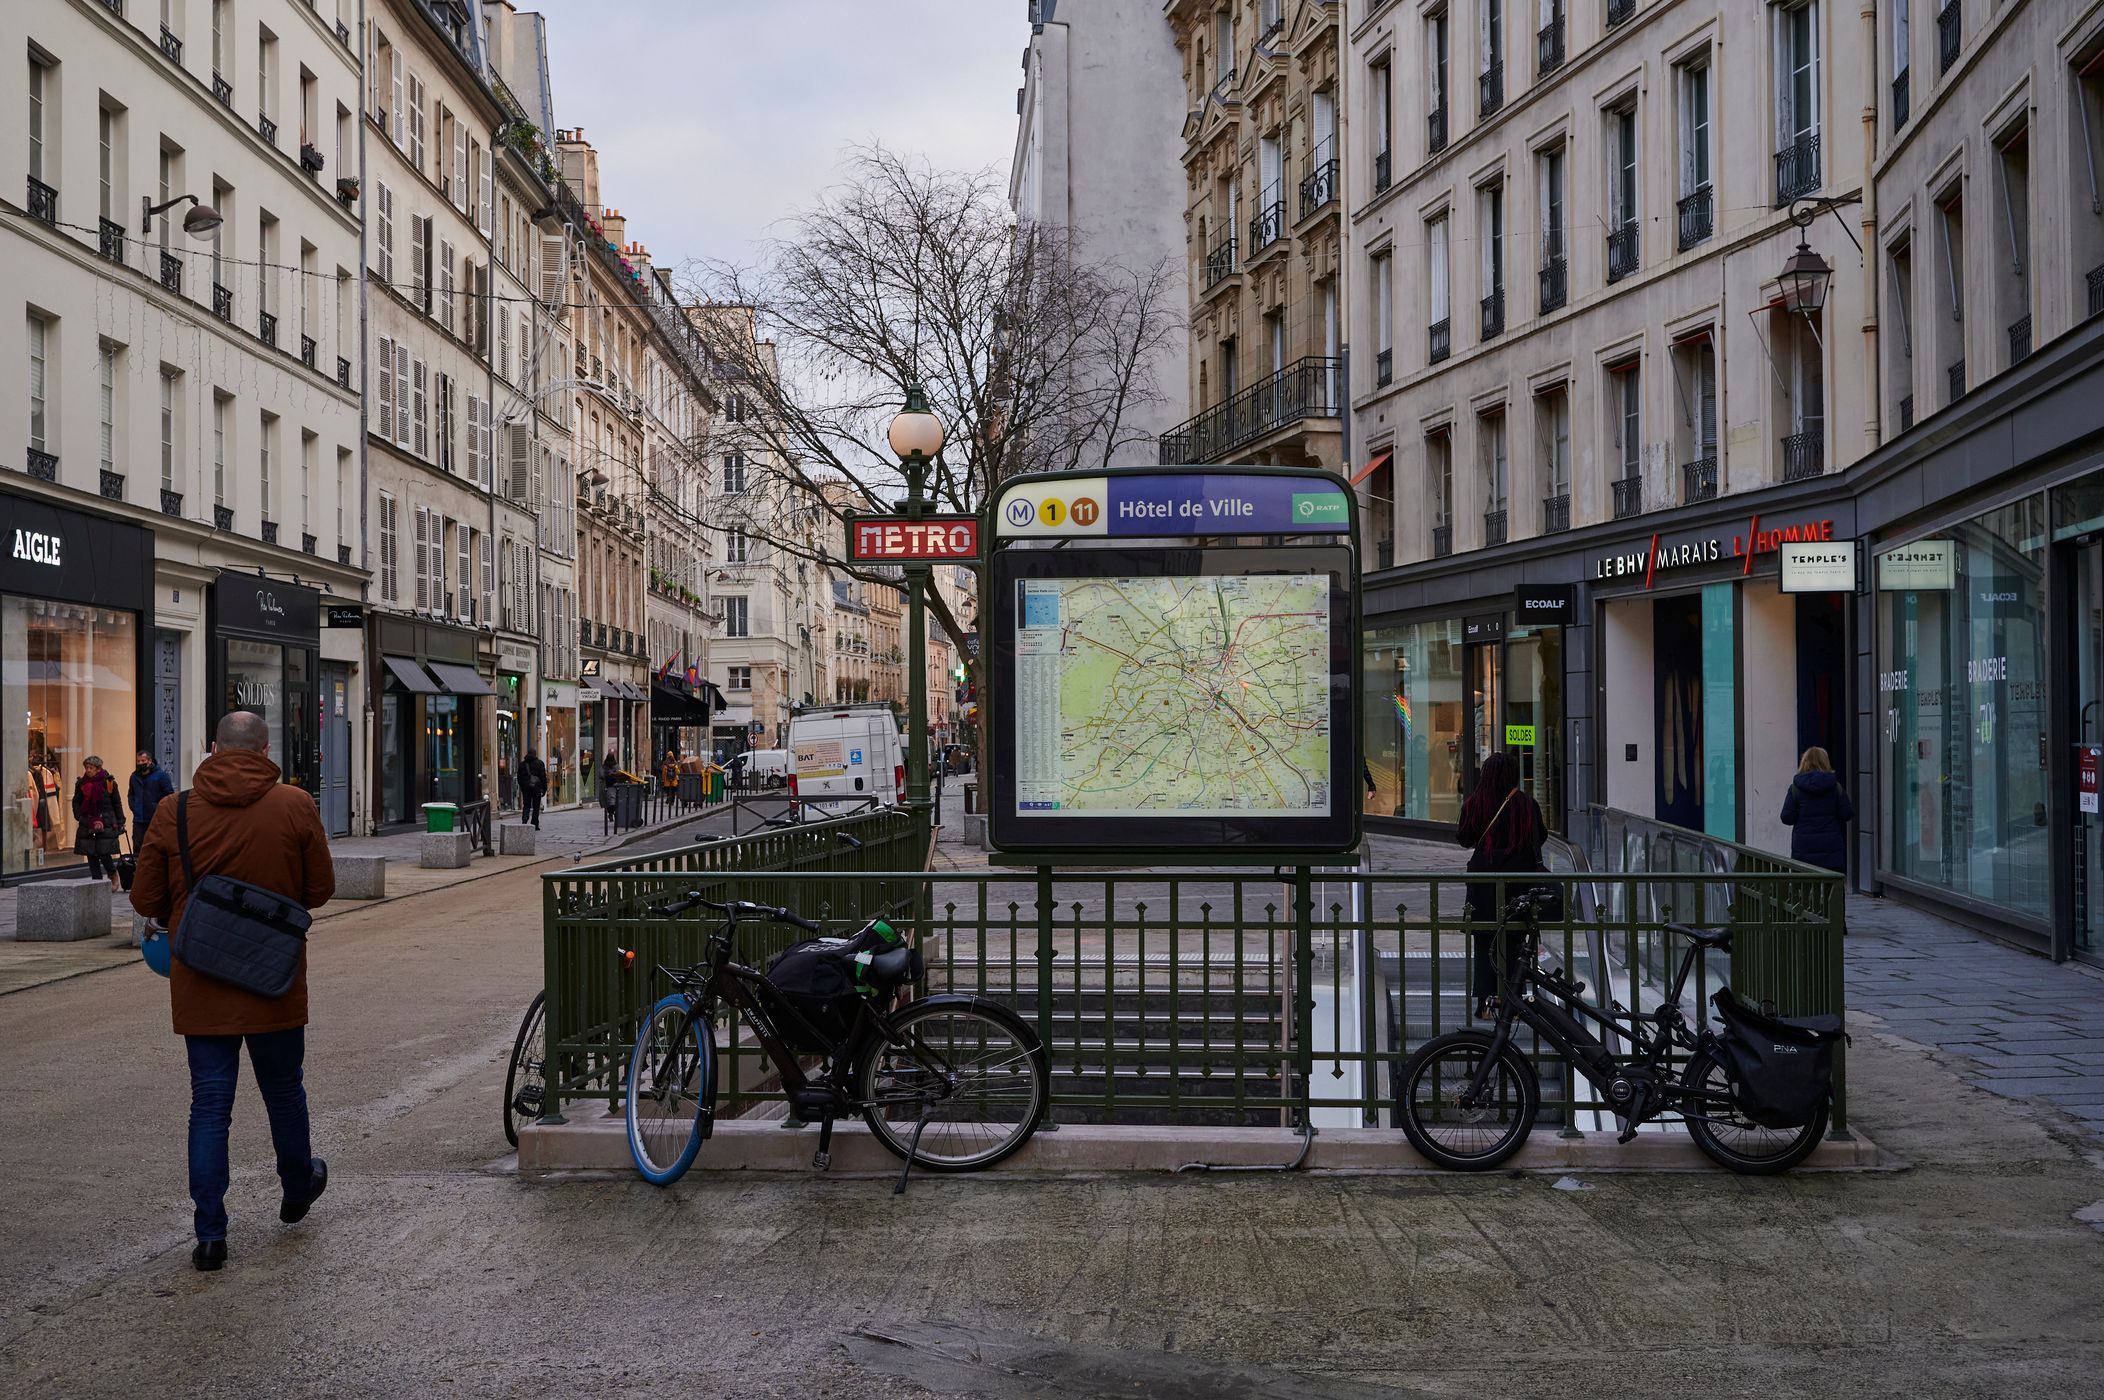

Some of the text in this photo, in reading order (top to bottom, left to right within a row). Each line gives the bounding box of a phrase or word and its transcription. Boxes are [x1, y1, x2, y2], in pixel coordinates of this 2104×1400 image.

[1047, 504, 1057, 521] 1
[1075, 503, 1093, 520] 11
[1119, 499, 1173, 518] Hôtel
[1179, 500, 1203, 518] de
[1209, 499, 1254, 517] Ville
[12, 528, 61, 566] AIGLE
[860, 524, 971, 554] METRO
[1597, 557, 1612, 578] LE
[1791, 554, 1847, 564] TEMPLE'S
[1525, 599, 1565, 609] ECOALF
[1968, 656, 2007, 683] BRADERIE
[1880, 670, 1908, 692] BRADERIE
[236, 681, 276, 706] SOLDES
[1509, 729, 1532, 742] SOLDES
[798, 753, 815, 762] BAT
